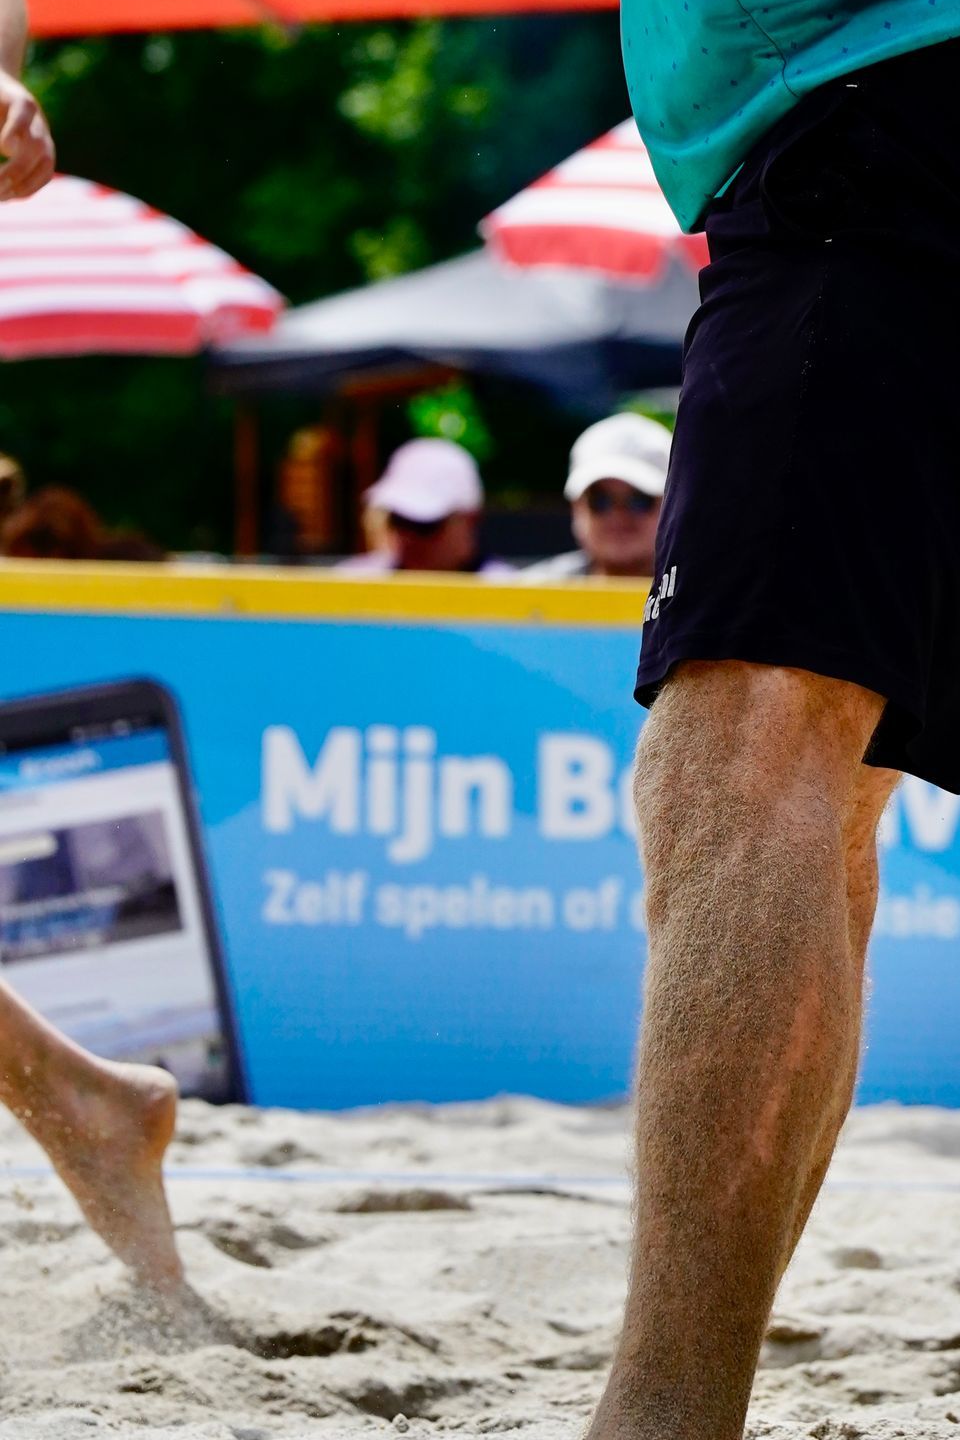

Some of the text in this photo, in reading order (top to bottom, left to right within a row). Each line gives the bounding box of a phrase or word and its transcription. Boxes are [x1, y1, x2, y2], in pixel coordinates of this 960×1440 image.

[259, 723, 513, 864] Mijn
[262, 870, 371, 926] Zelf
[376, 872, 555, 939] spelen
[562, 875, 622, 932] of
